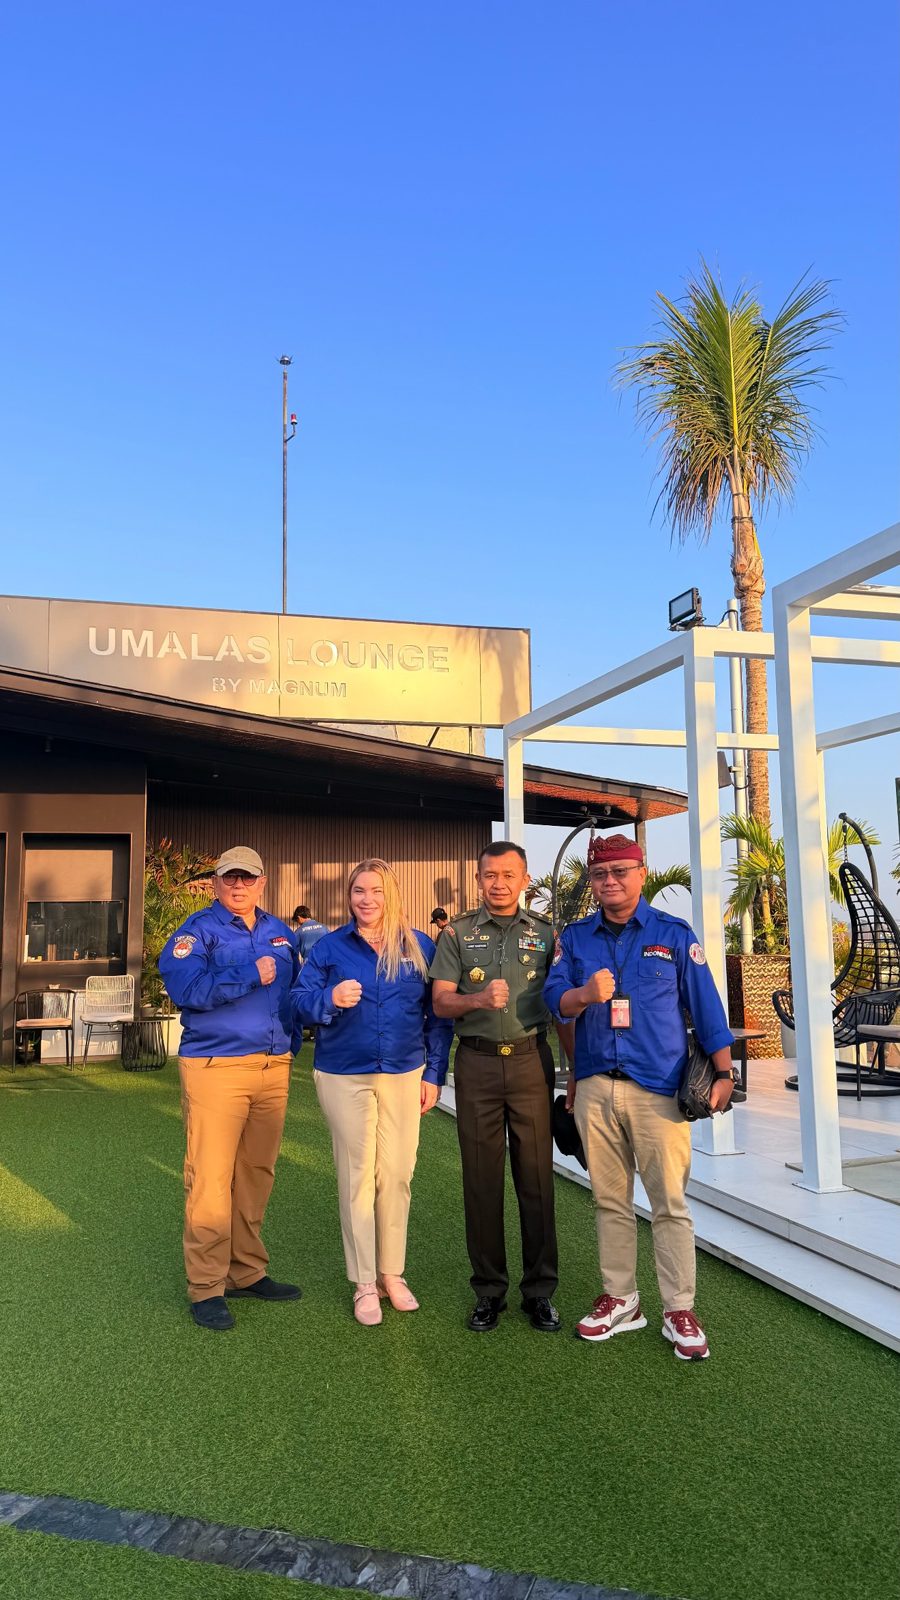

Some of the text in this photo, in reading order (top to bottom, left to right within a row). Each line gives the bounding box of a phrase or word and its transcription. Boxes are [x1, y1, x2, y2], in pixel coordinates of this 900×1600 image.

[88, 626, 450, 673] UMALAS LOUNGE
[212, 677, 348, 698] BY MAGNUM
[643, 950, 673, 961] INDONESIA
